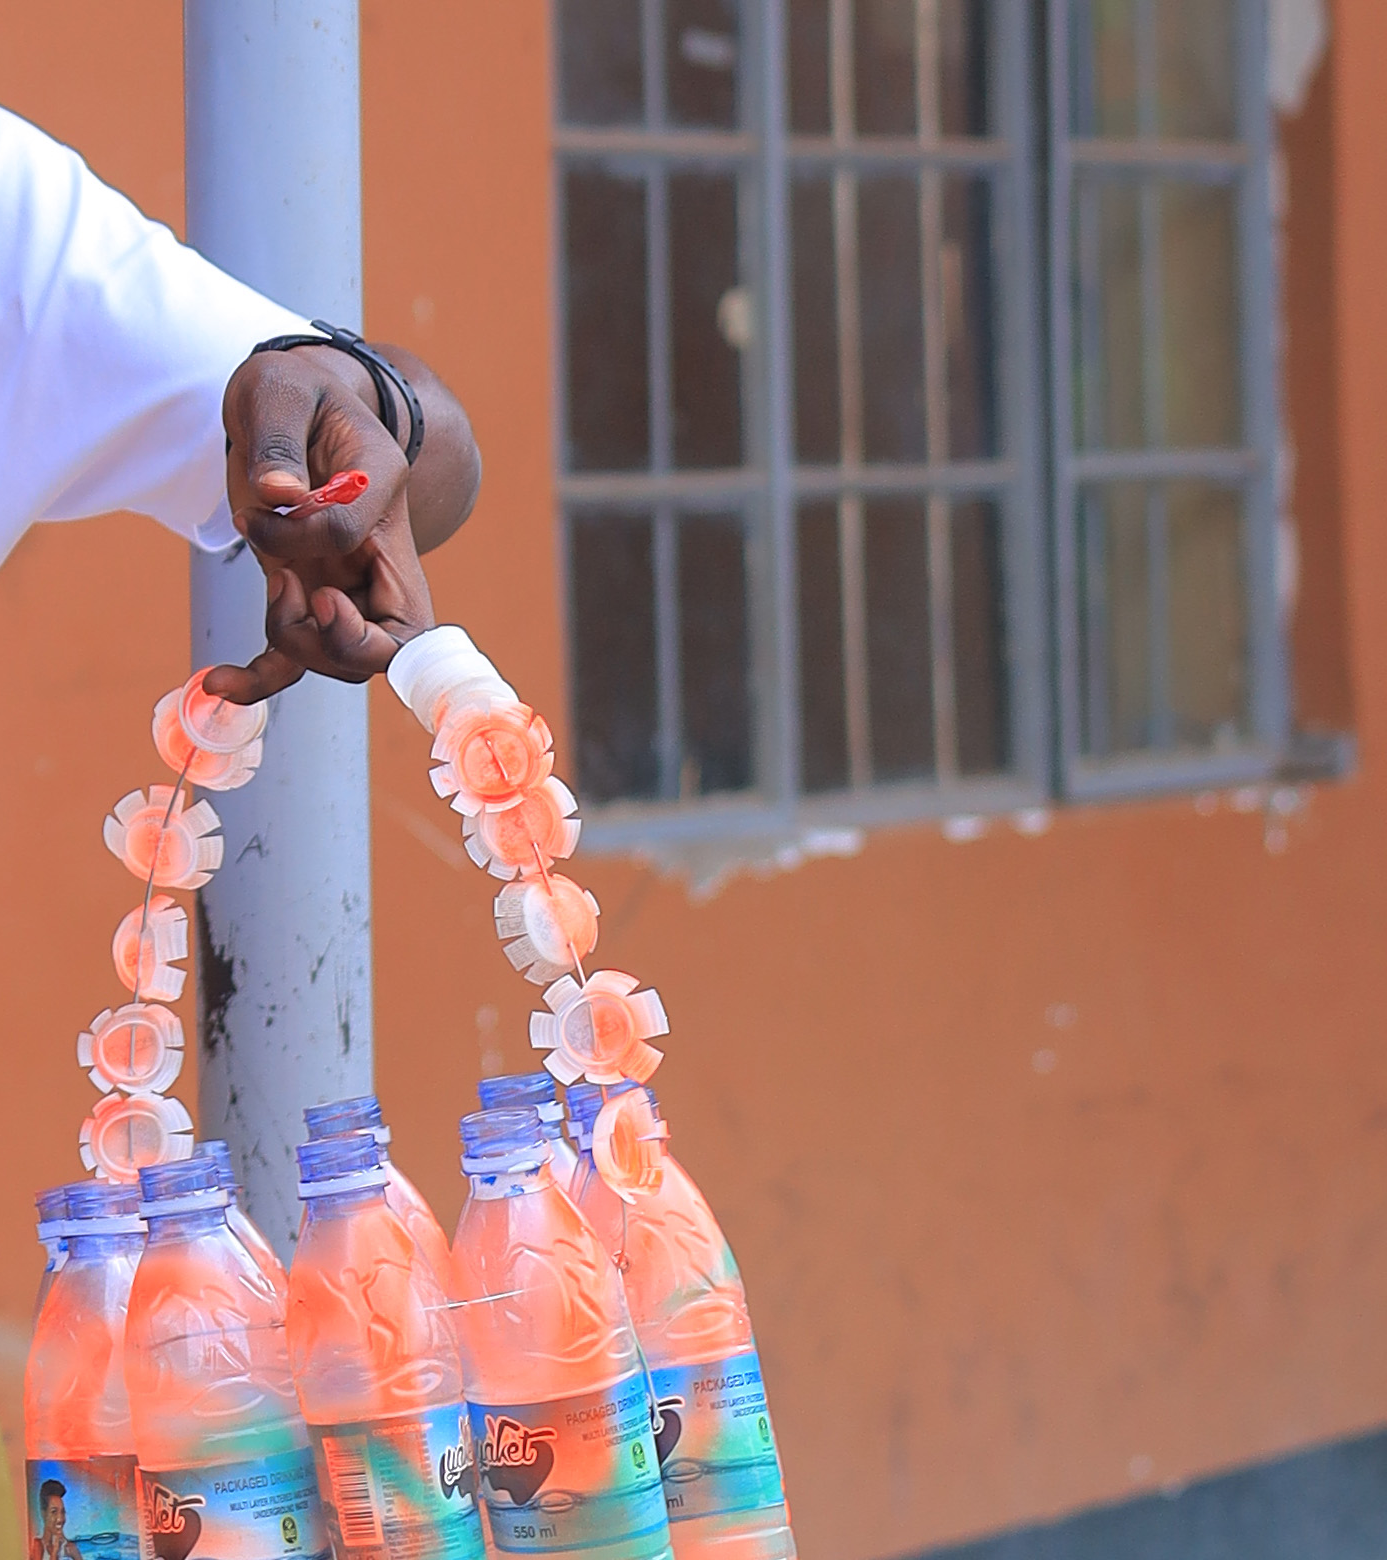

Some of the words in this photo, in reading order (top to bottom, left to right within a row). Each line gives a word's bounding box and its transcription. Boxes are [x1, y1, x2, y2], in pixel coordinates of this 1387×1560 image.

[693, 1373, 744, 1394] PACKAGED
[565, 1402, 617, 1426] PACKAGED
[214, 1475, 268, 1495] PACKAGED
[513, 1525, 535, 1539] 550
[540, 1523, 557, 1538] ml
